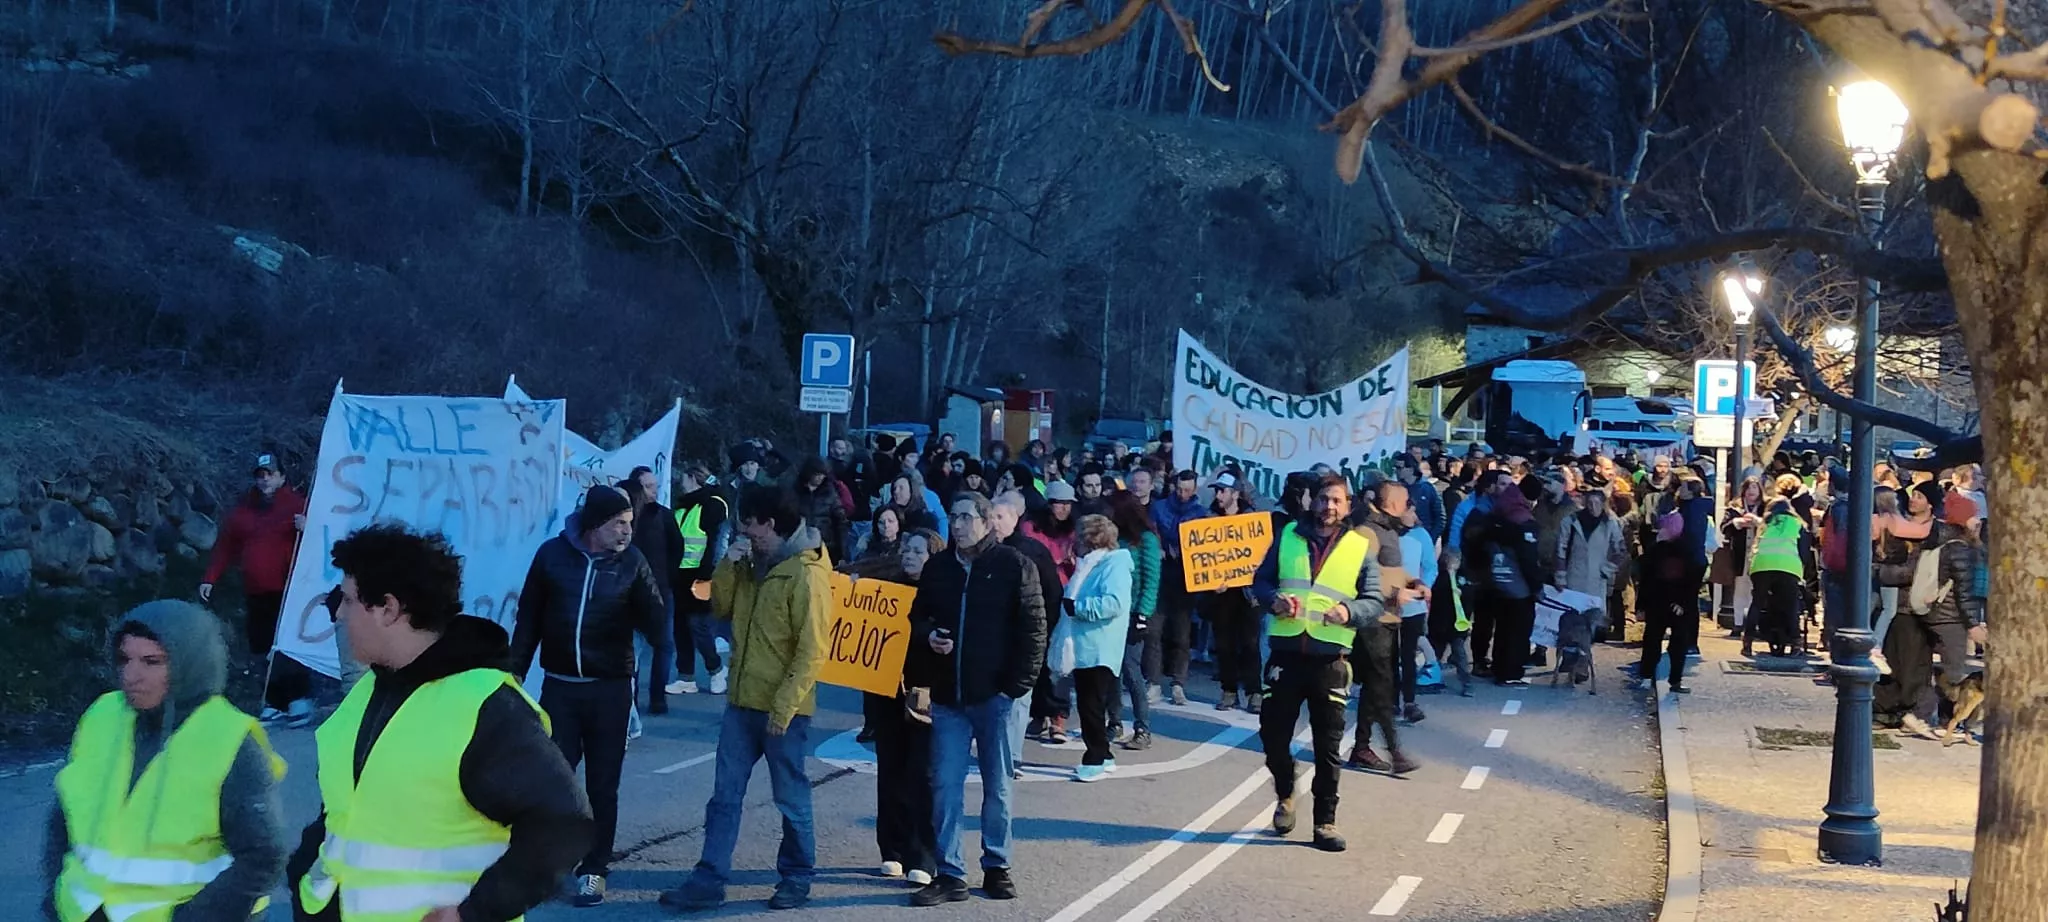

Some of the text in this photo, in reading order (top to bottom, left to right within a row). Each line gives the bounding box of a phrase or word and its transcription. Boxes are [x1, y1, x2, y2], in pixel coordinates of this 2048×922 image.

[811, 341, 841, 379] P
[1358, 364, 1395, 401] DE
[1706, 367, 1738, 411] P
[341, 402, 490, 455] VALLE
[1308, 423, 1343, 450] NO
[1189, 520, 1265, 548] ALGUIEN HA
[1190, 546, 1252, 570] PENSADO
[1193, 570, 1210, 585] EN
[843, 583, 899, 618] Juntos
